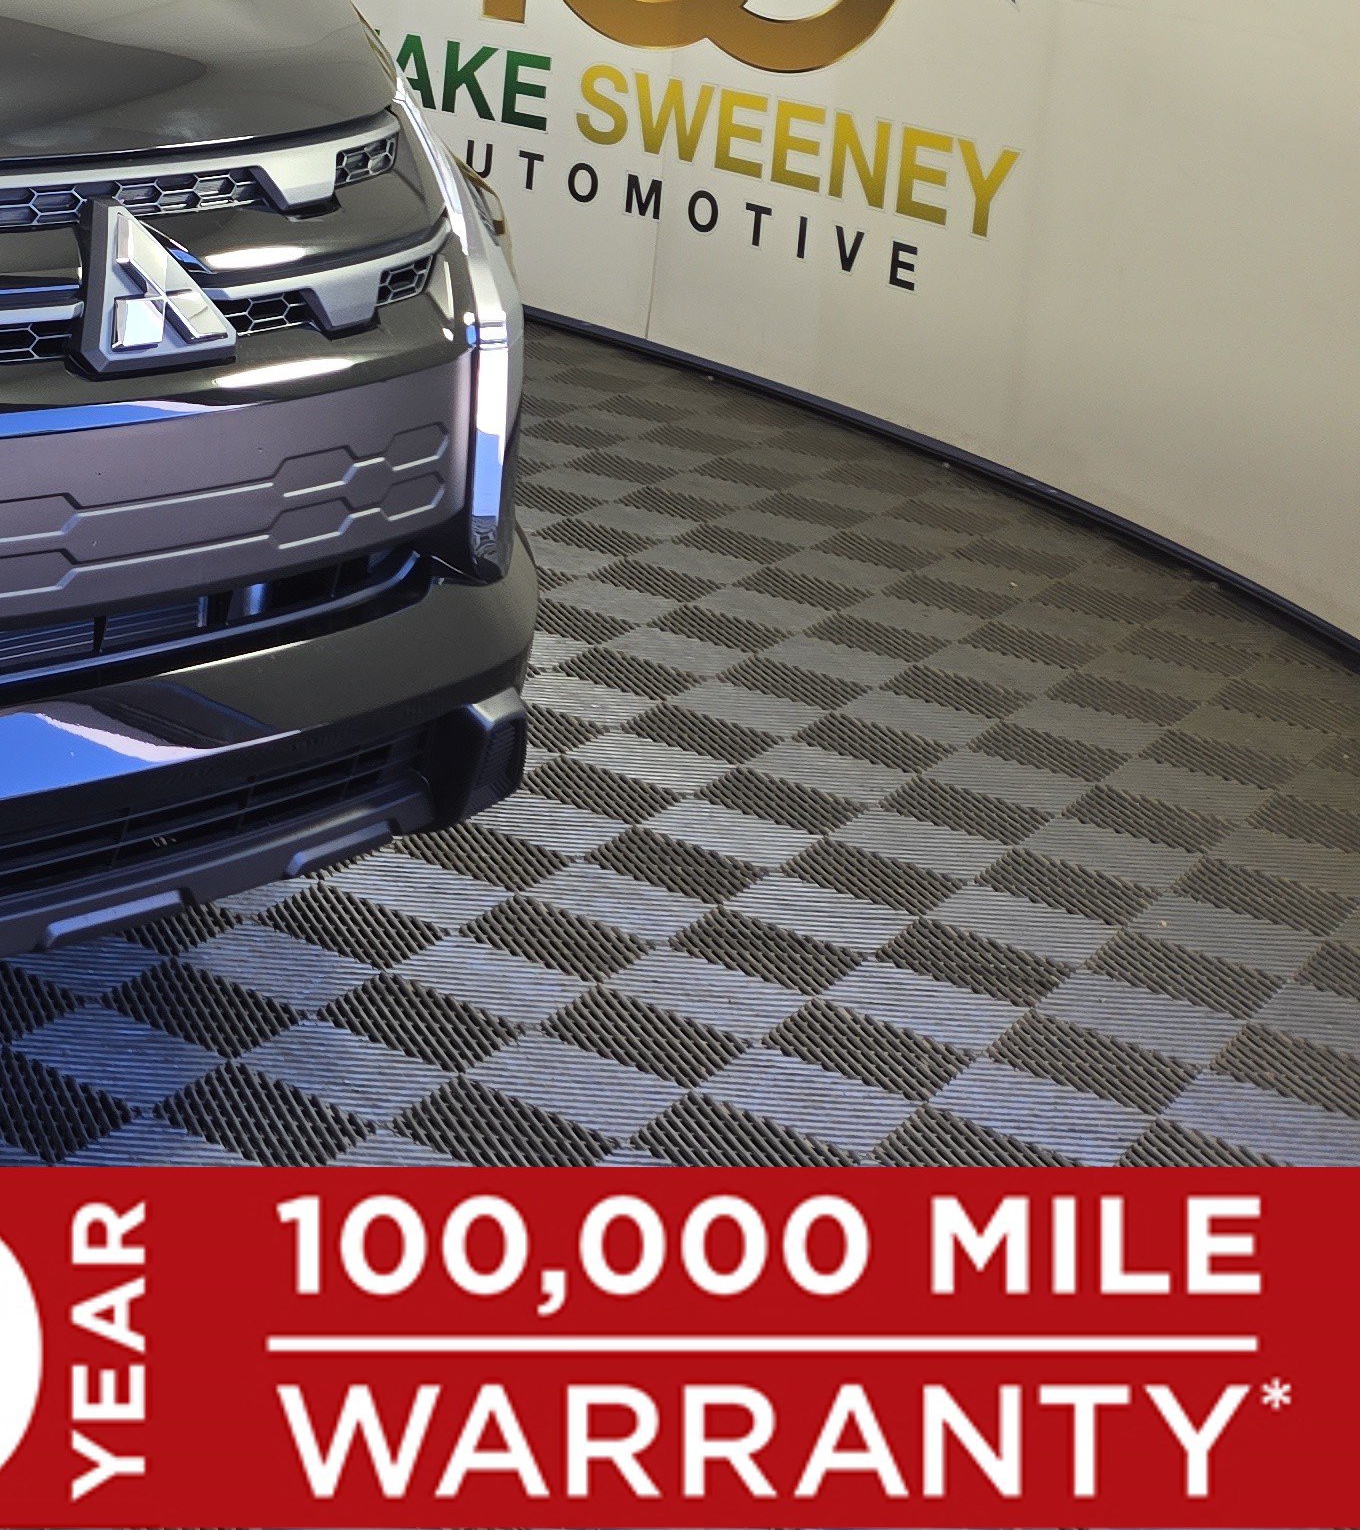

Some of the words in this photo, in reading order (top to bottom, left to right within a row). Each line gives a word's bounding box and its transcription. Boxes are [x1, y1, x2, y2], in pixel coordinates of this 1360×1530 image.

[375, 29, 552, 132] AKE
[576, 64, 1022, 239] SWEENEY
[466, 139, 919, 292] UTOMOTIVE
